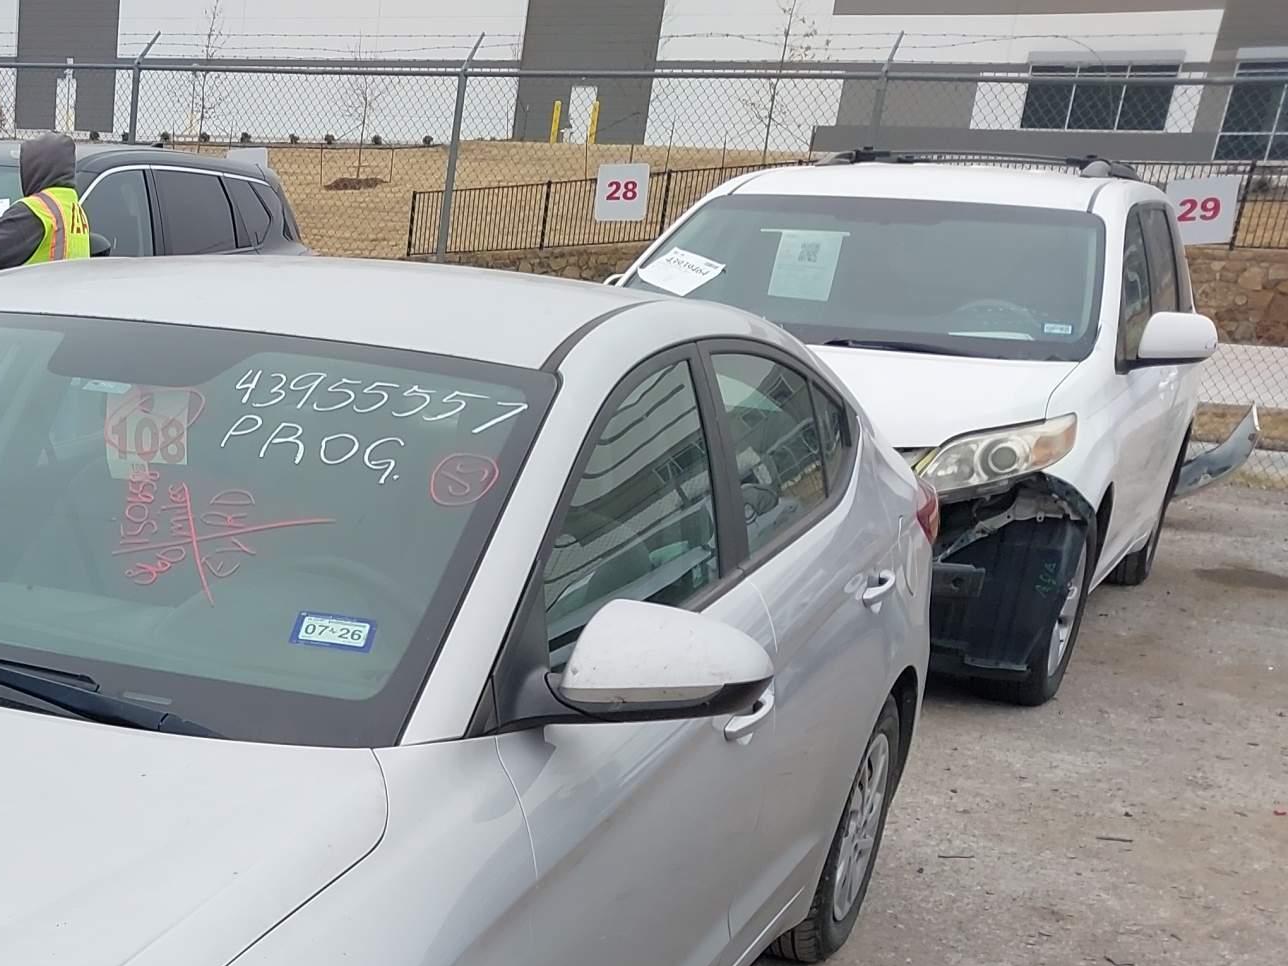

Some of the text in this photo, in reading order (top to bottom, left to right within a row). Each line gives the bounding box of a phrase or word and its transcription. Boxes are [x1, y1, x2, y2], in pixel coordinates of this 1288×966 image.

[605, 180, 638, 201] 28
[1177, 197, 1221, 222] 29
[235, 369, 529, 434] 43955557
[110, 416, 186, 464] 108
[304, 623, 363, 641] 07 26
